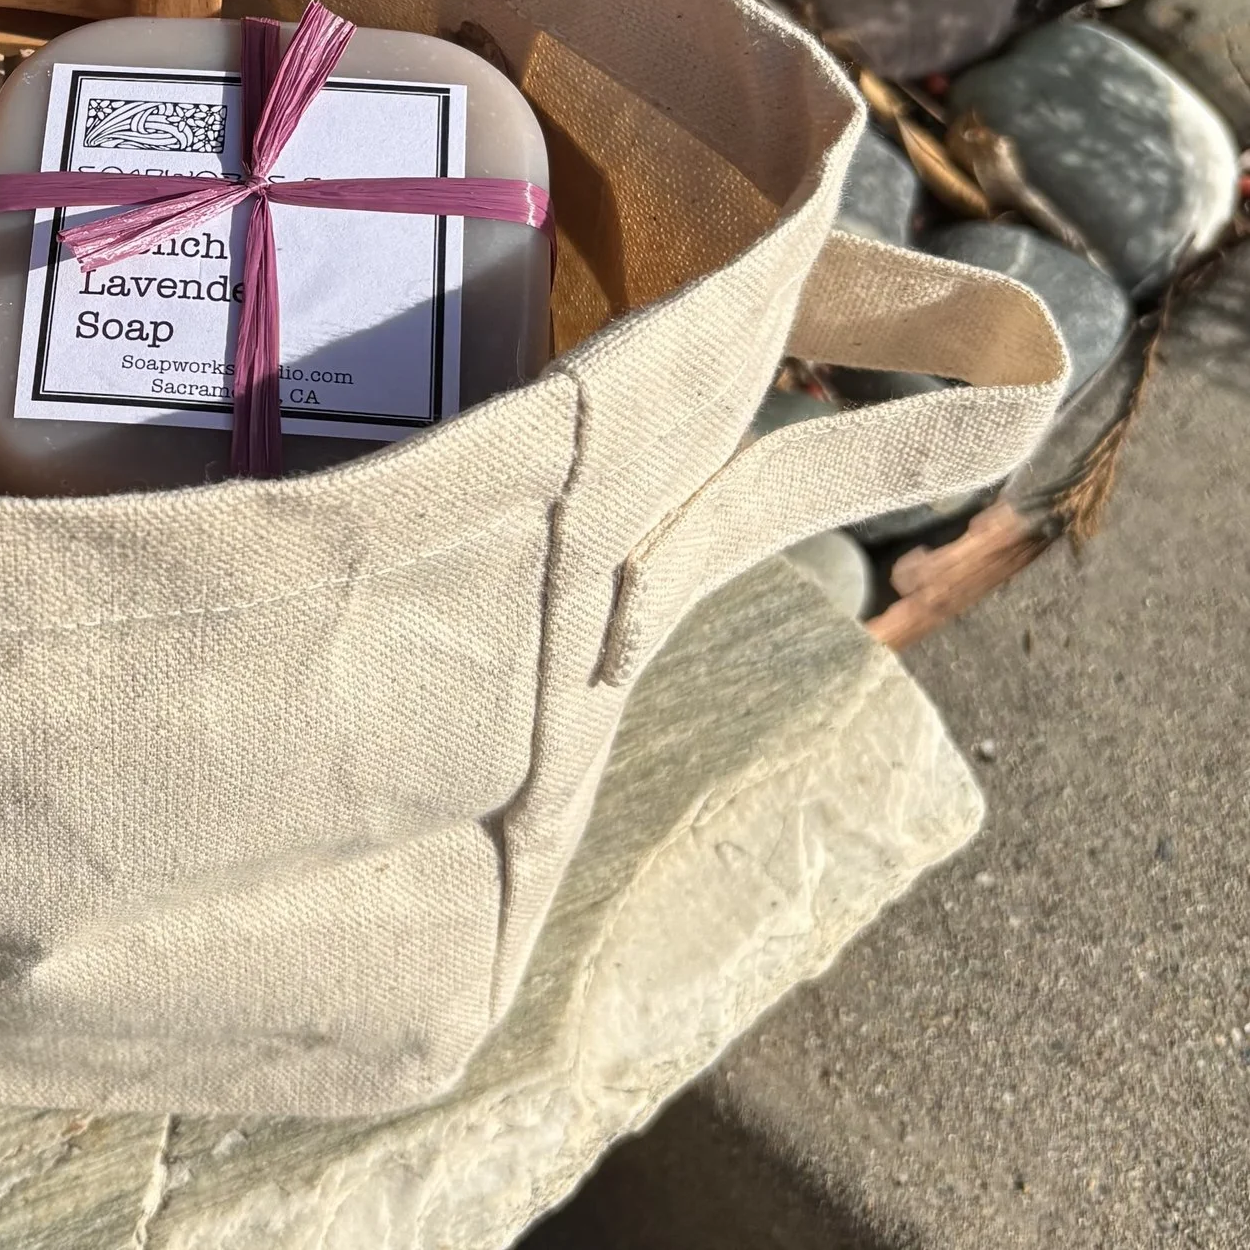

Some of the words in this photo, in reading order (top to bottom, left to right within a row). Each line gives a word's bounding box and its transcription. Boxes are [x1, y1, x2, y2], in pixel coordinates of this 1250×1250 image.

[79, 269, 245, 303] Lavende
[75, 311, 175, 348] Soap
[290, 389, 320, 405] CA
